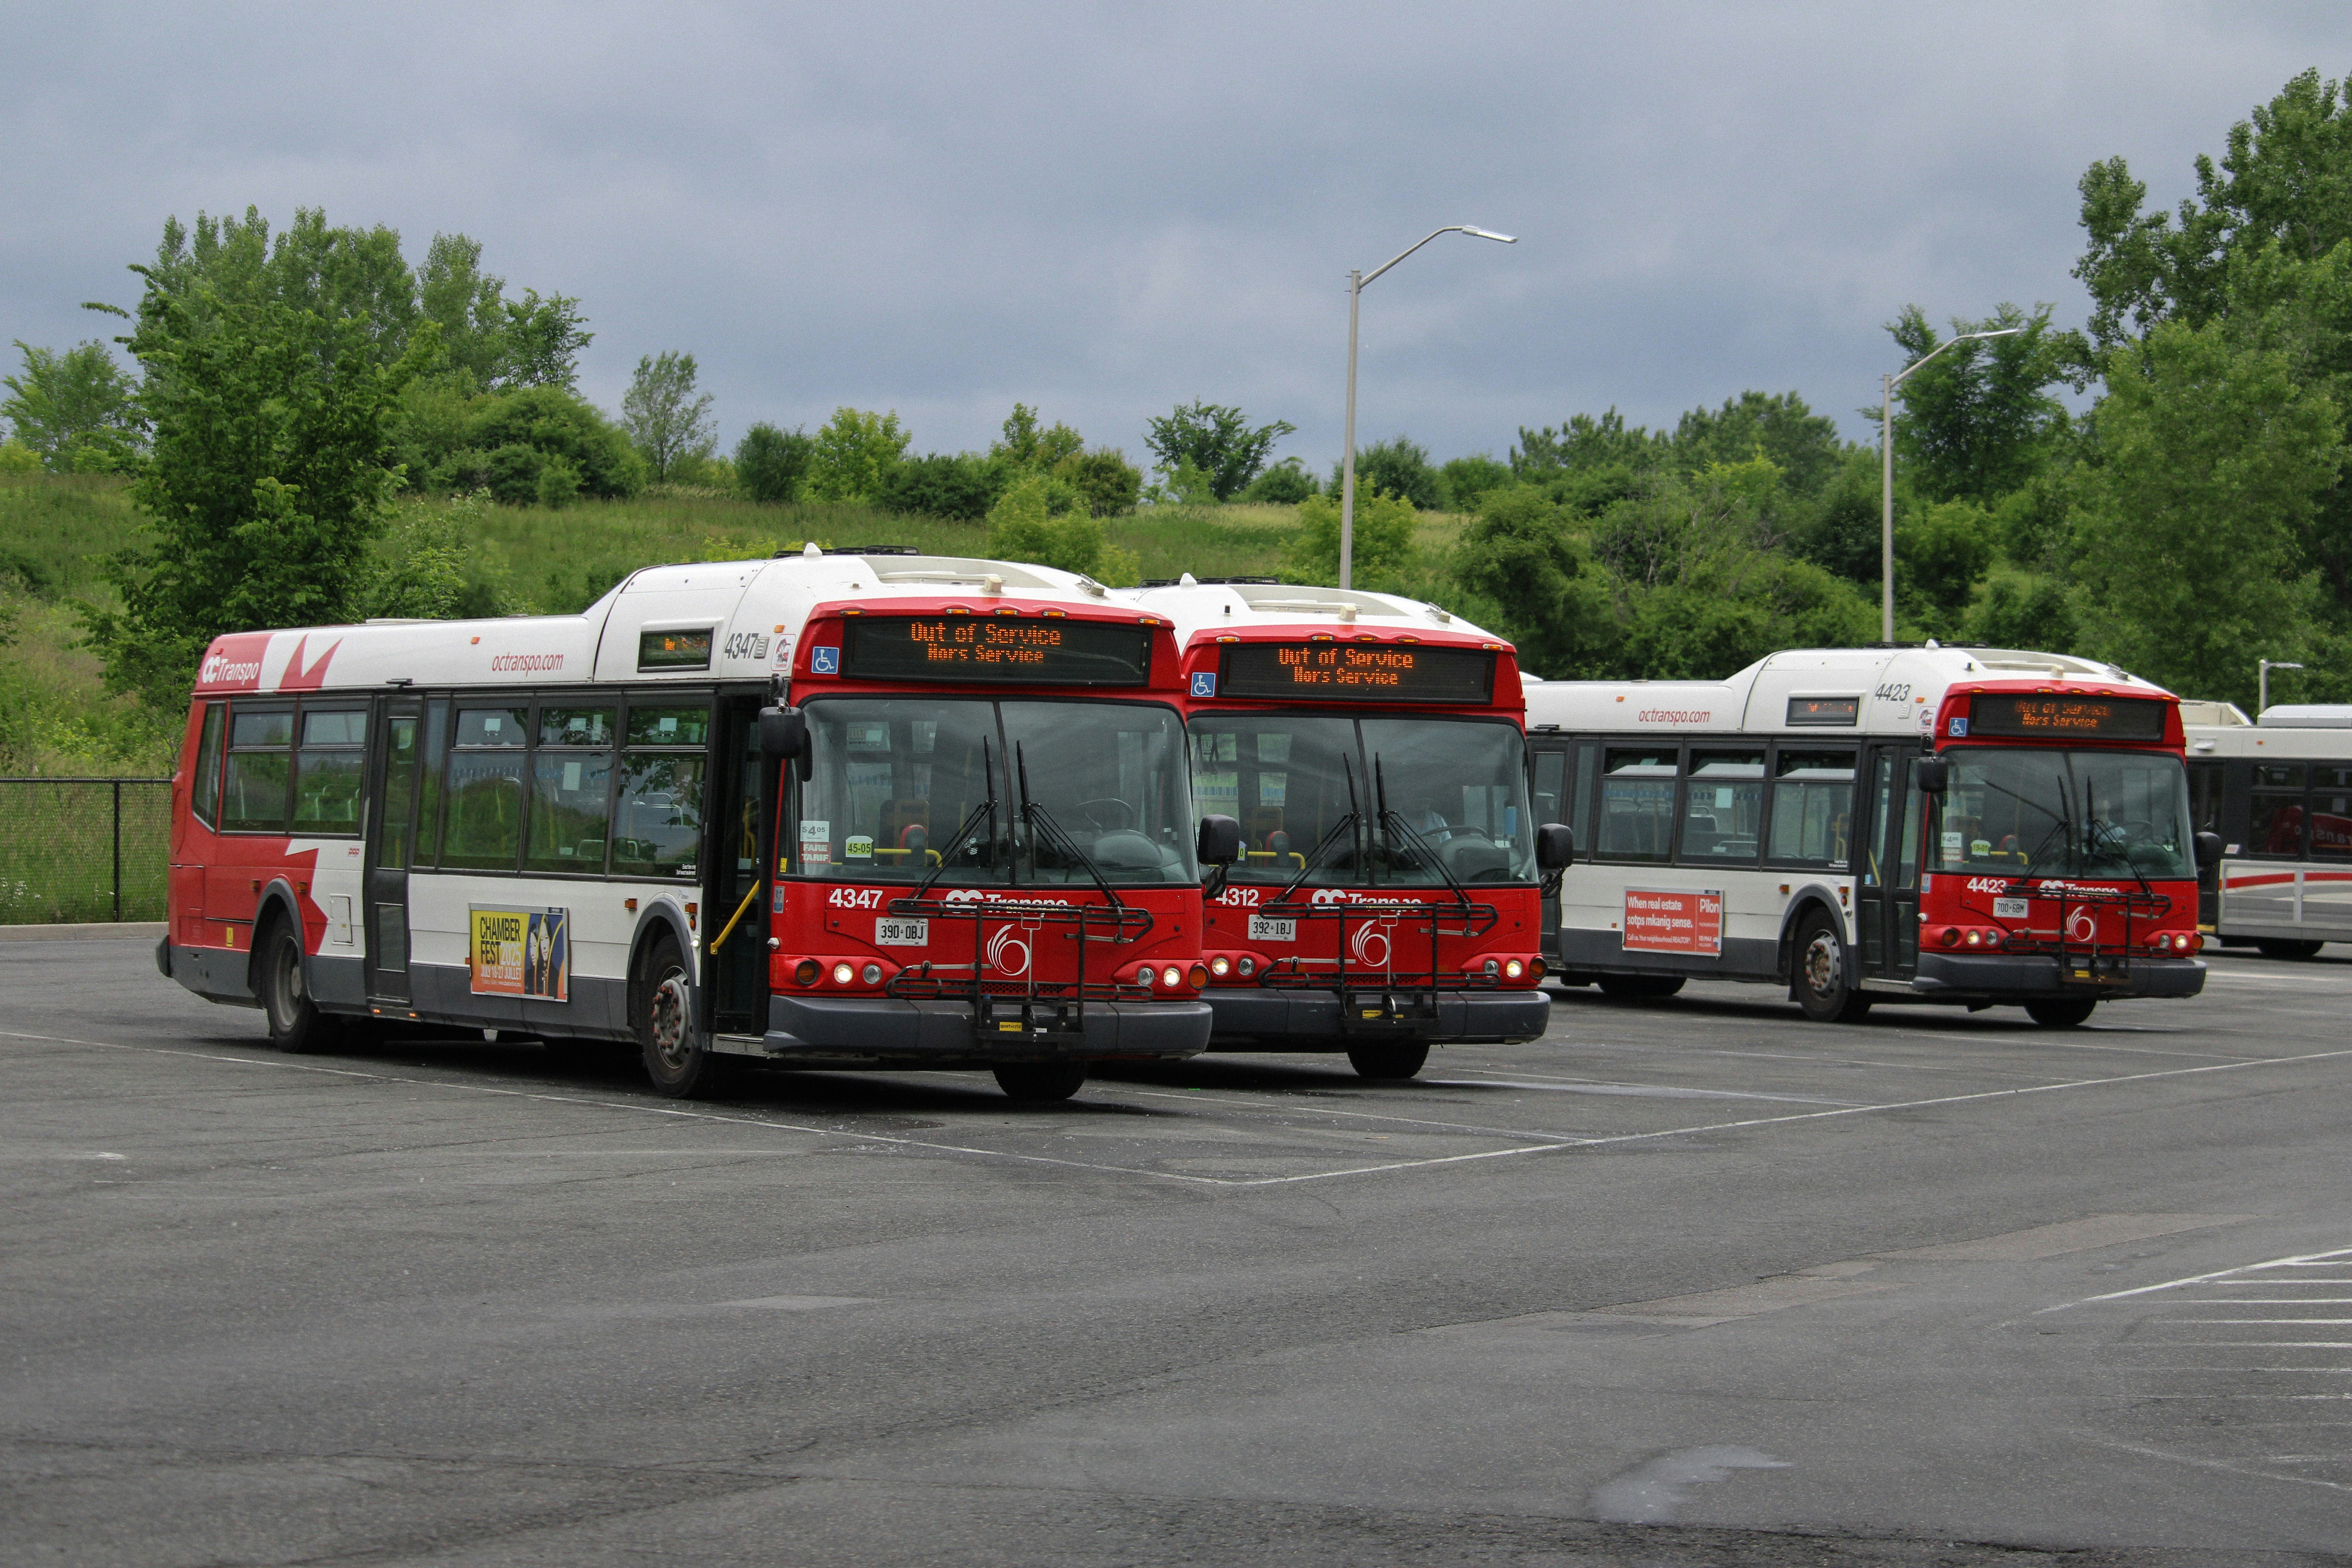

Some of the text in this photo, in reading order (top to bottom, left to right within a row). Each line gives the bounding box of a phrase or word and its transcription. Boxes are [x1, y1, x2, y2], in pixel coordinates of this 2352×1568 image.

[911, 622, 1061, 645] Out of Service
[724, 633, 760, 659] 4347
[928, 643, 1044, 663] Hors Service
[492, 652, 564, 677] octranspo.com
[1279, 648, 1413, 668] Out of Service
[217, 659, 260, 686] Transpo
[1294, 666, 1398, 685] Hors Service
[1874, 683, 1911, 702] 4423
[1638, 708, 1710, 726] octranspo.com
[803, 844, 828, 852] FARE
[848, 843, 871, 853] 45-05
[801, 853, 829, 862] TARIF
[1967, 877, 2006, 893] 4423
[829, 888, 883, 909] 4347
[1215, 888, 1259, 906] 4312
[1627, 896, 1682, 911] When real estate
[1699, 898, 1719, 913] Pilon
[480, 916, 521, 942] CHAMBER
[881, 925, 899, 938] 390
[1253, 922, 1270, 934] 392
[1627, 914, 1693, 931] sotps mkanig sense.
